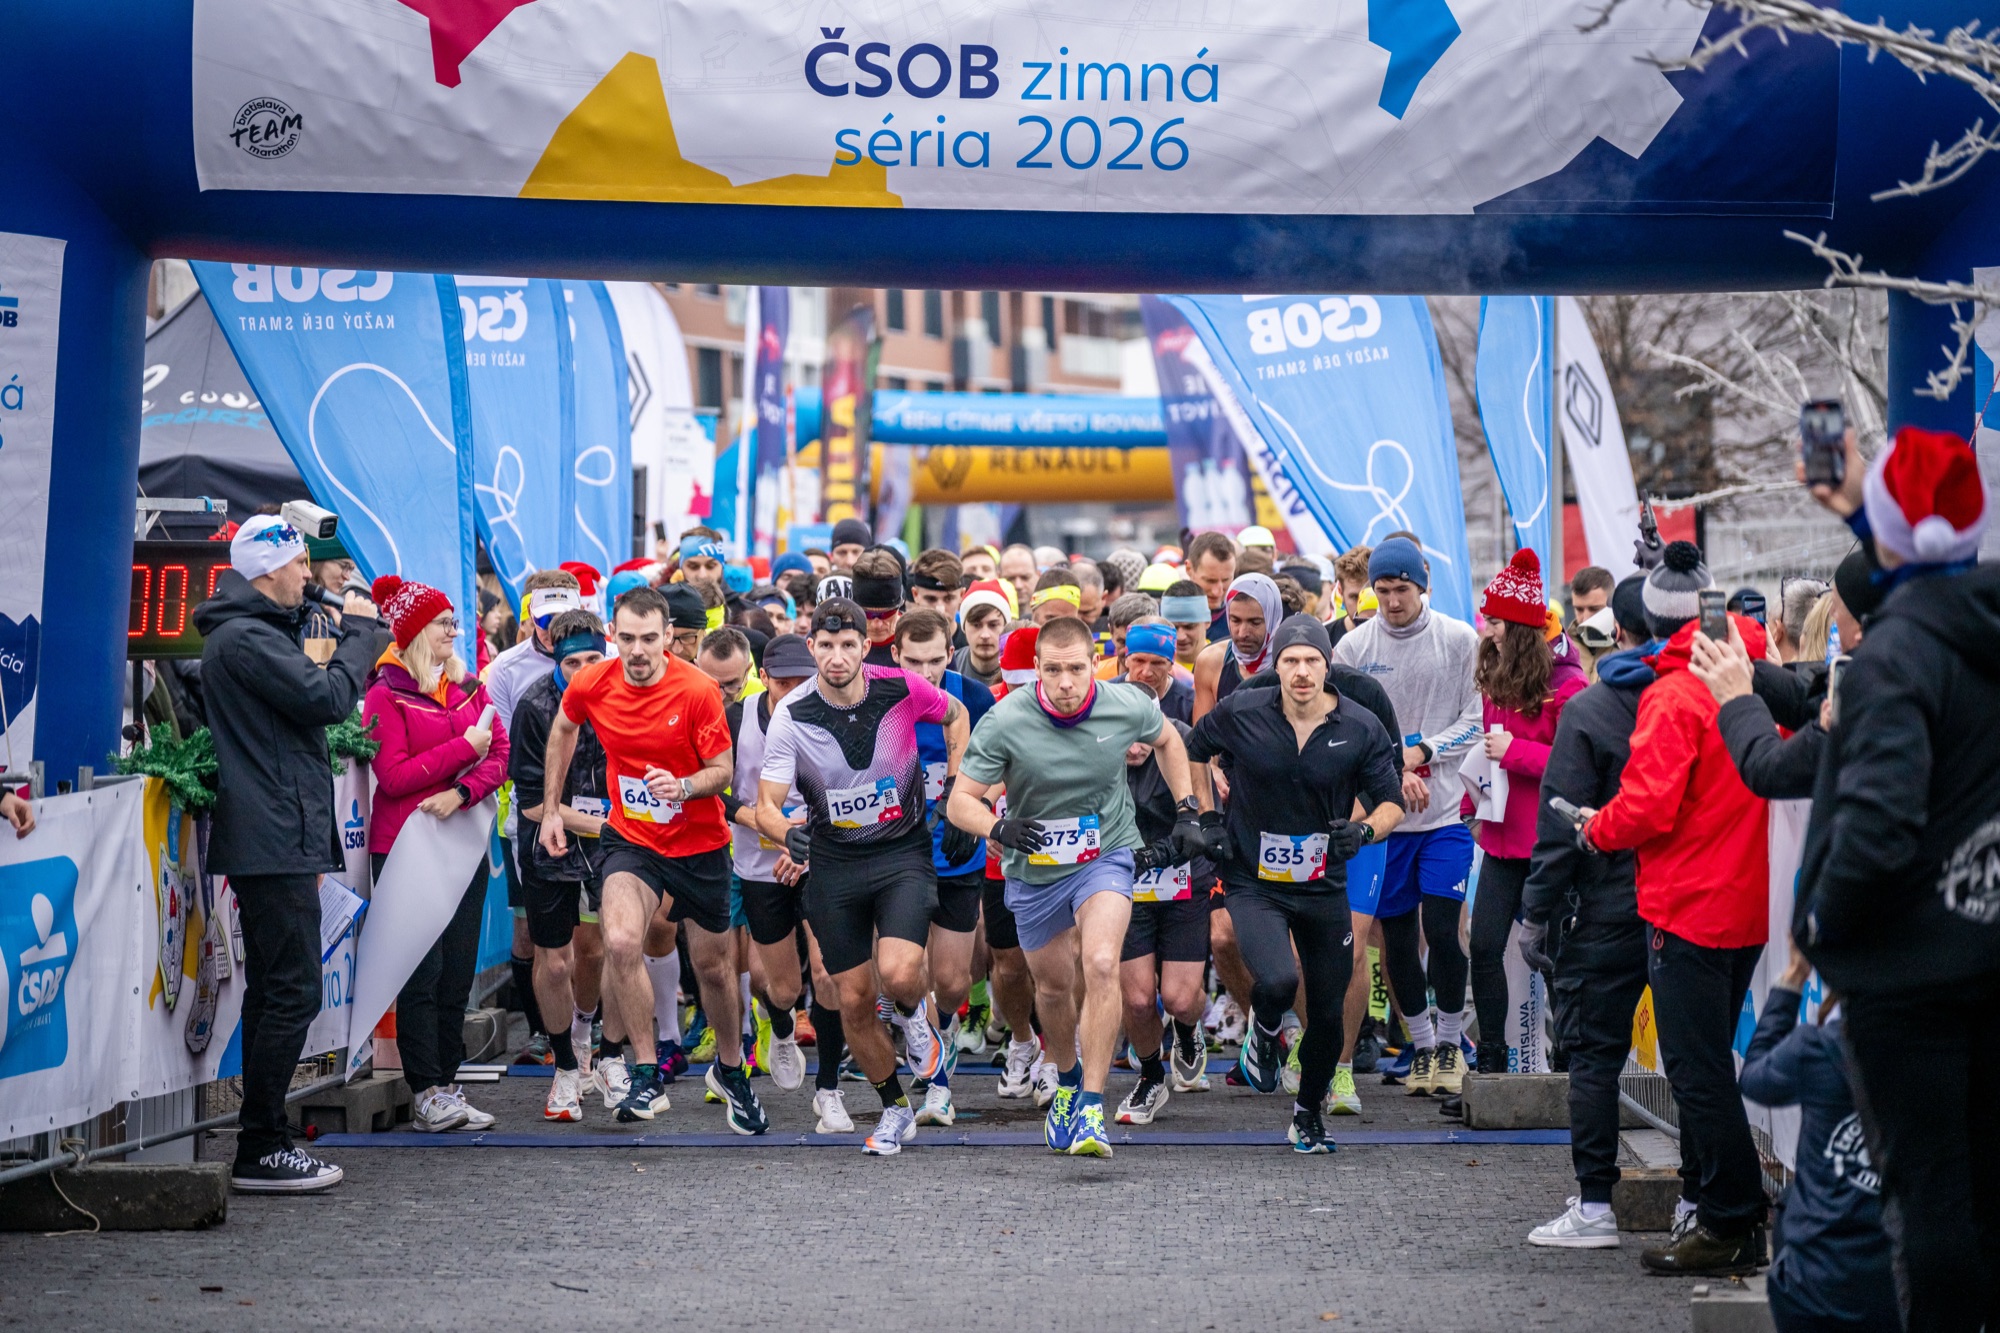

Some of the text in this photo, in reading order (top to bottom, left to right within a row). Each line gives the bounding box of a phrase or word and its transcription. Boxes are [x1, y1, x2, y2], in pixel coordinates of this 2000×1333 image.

[804, 27, 1220, 103] ČSOB zimná
[236, 100, 286, 126] bratislava
[229, 113, 303, 148] TEAM
[834, 112, 1190, 171] séria 2026
[249, 133, 298, 157] marathon
[831, 793, 880, 817] 1502
[345, 830, 365, 850] ČSOB
[1042, 829, 1079, 847] 673
[1264, 847, 1304, 865] 635
[18, 965, 65, 1017] ČSOB
[1520, 1001, 1531, 1073] RATISLAVA
